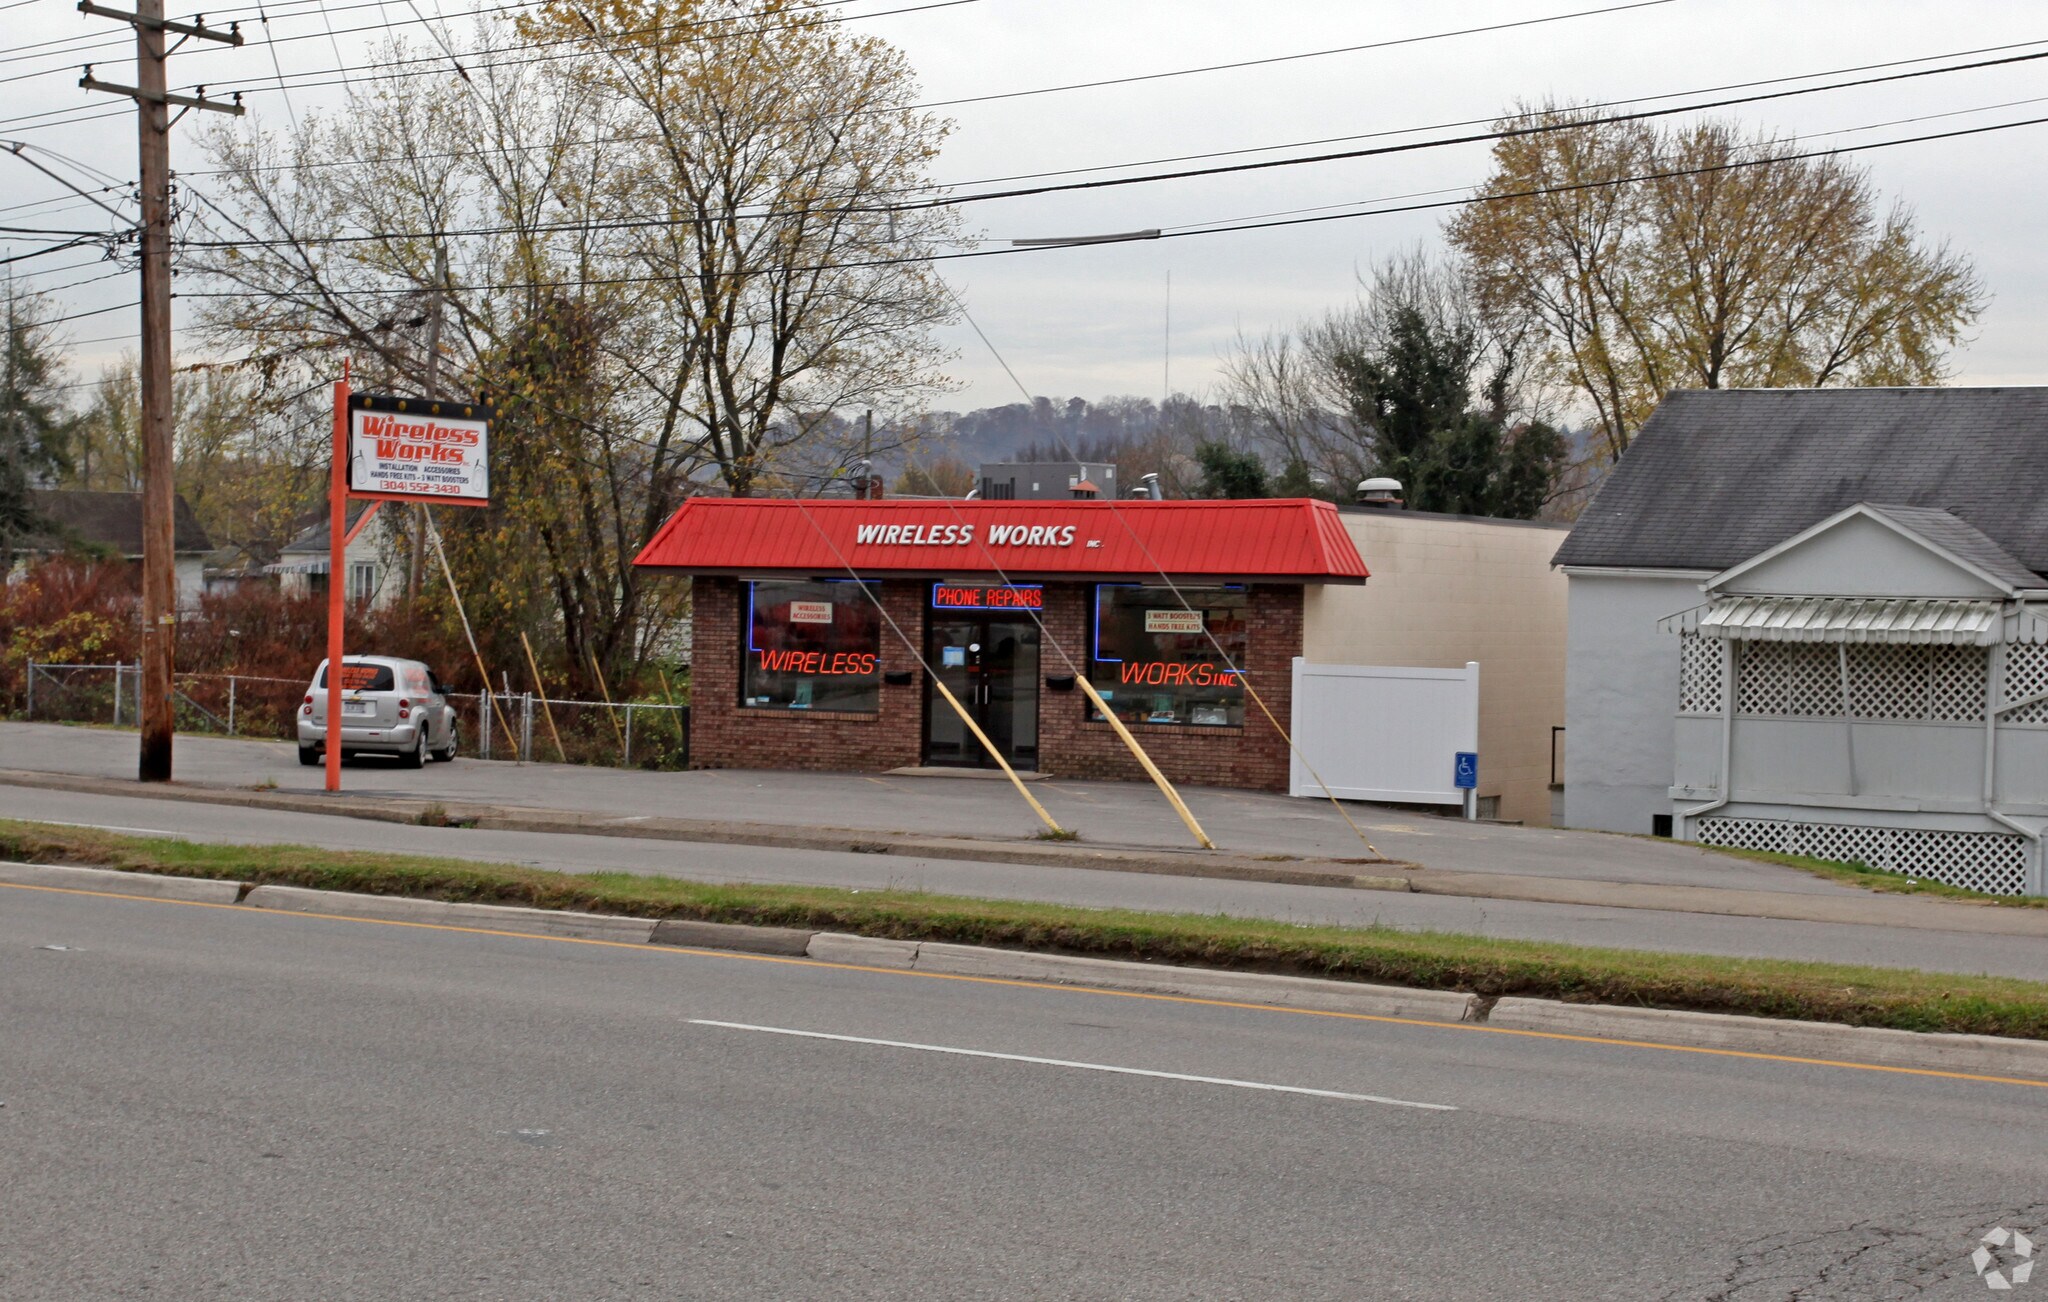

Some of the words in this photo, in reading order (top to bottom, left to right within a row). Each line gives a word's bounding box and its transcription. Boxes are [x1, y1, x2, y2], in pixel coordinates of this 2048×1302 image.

[361, 415, 479, 447] Wireless
[375, 439, 464, 466] Works
[370, 471, 389, 479] HANDS
[390, 472, 403, 480] FREE
[404, 473, 416, 481] KITS
[426, 474, 441, 482] WATT
[442, 475, 470, 484] BOOSTERS
[379, 463, 418, 472] INSTALLATION
[424, 466, 460, 475] ACCESSORIES
[380, 480, 407, 491] (304)
[409, 482, 460, 494] 552-3430
[856, 524, 974, 545] WIRELESS
[988, 525, 1077, 547] WORKS
[937, 587, 981, 606] PHONE
[986, 589, 1042, 607] REPAIRS
[1186, 623, 1200, 631] KITS
[760, 650, 876, 675] WIRELESS
[1121, 662, 1214, 686] WORKS
